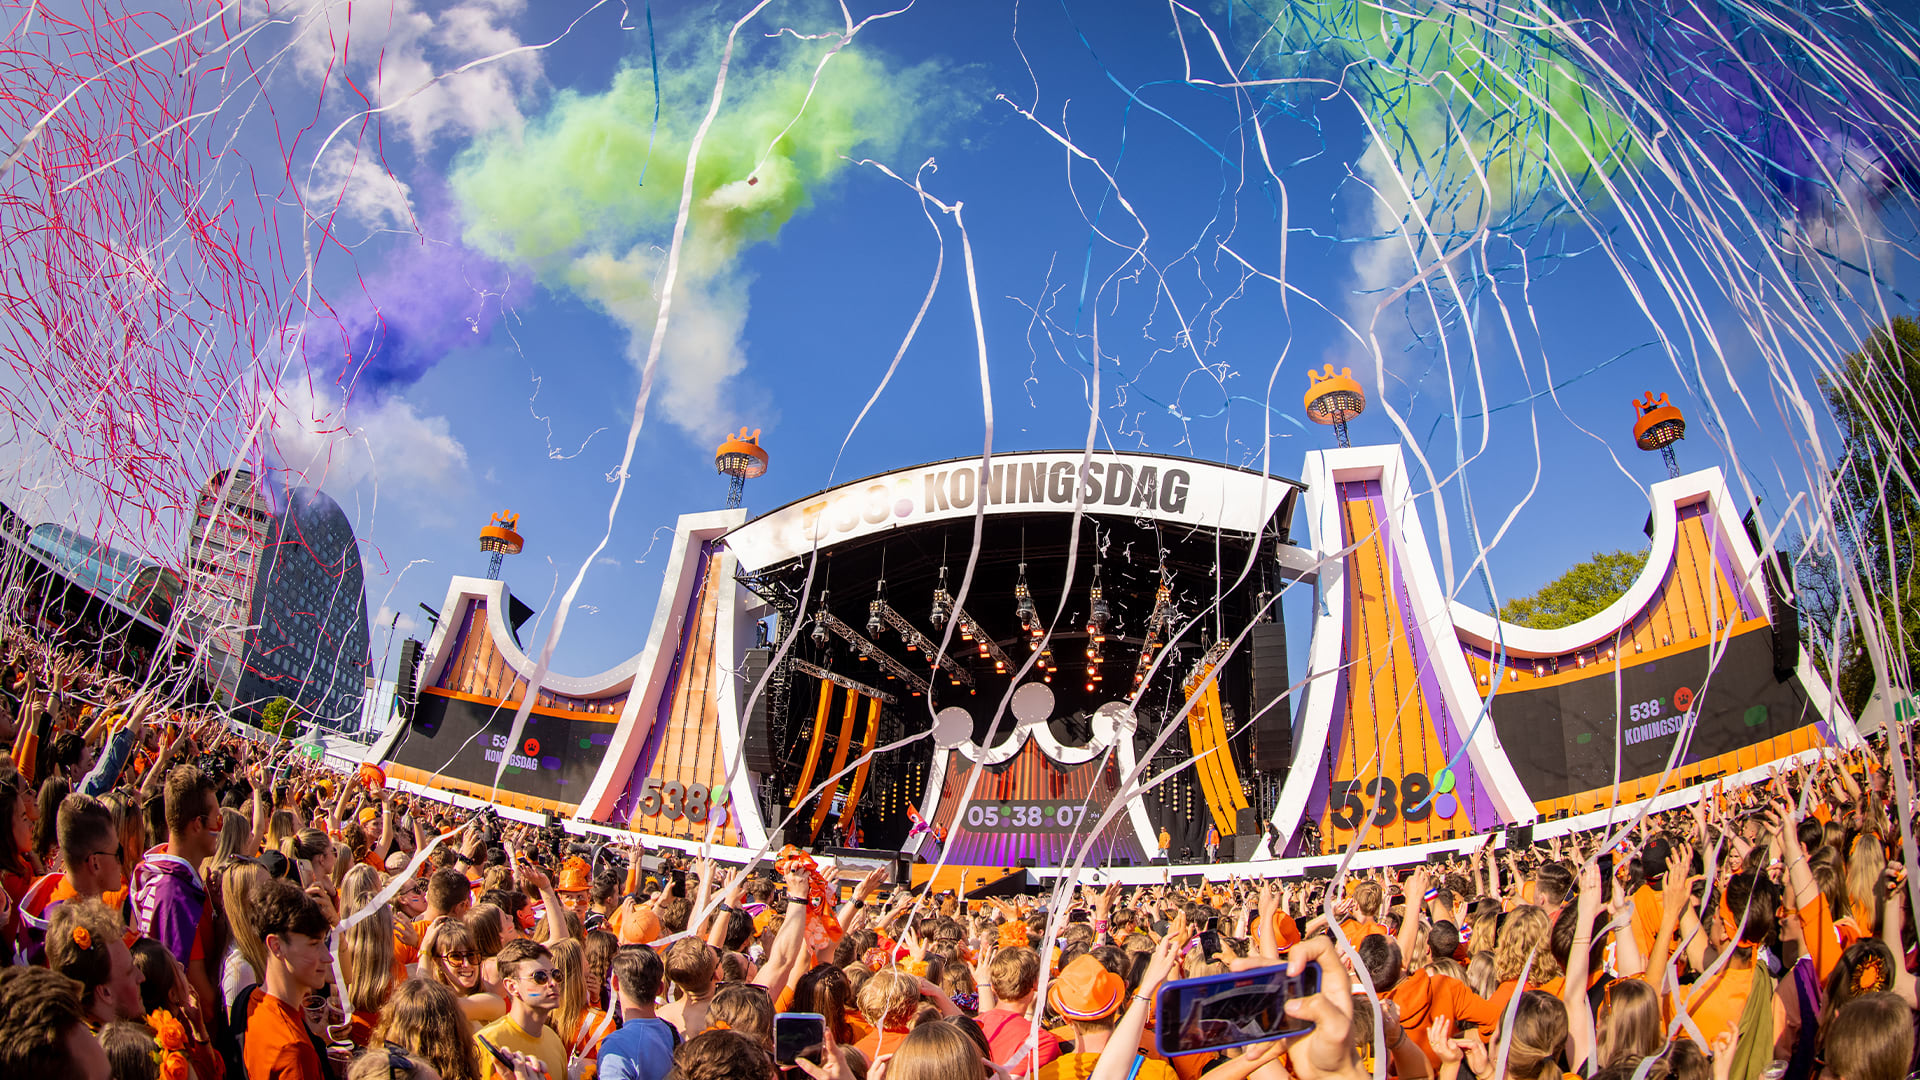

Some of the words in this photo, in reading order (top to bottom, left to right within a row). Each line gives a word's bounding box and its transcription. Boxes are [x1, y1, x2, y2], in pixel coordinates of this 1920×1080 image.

[924, 461, 1190, 514] KONINGSDAG
[1630, 699, 1660, 722] 538
[492, 734, 512, 749] 53
[484, 749, 538, 771] KONGSDAG
[639, 777, 708, 823] 538
[1330, 773, 1432, 830] 538
